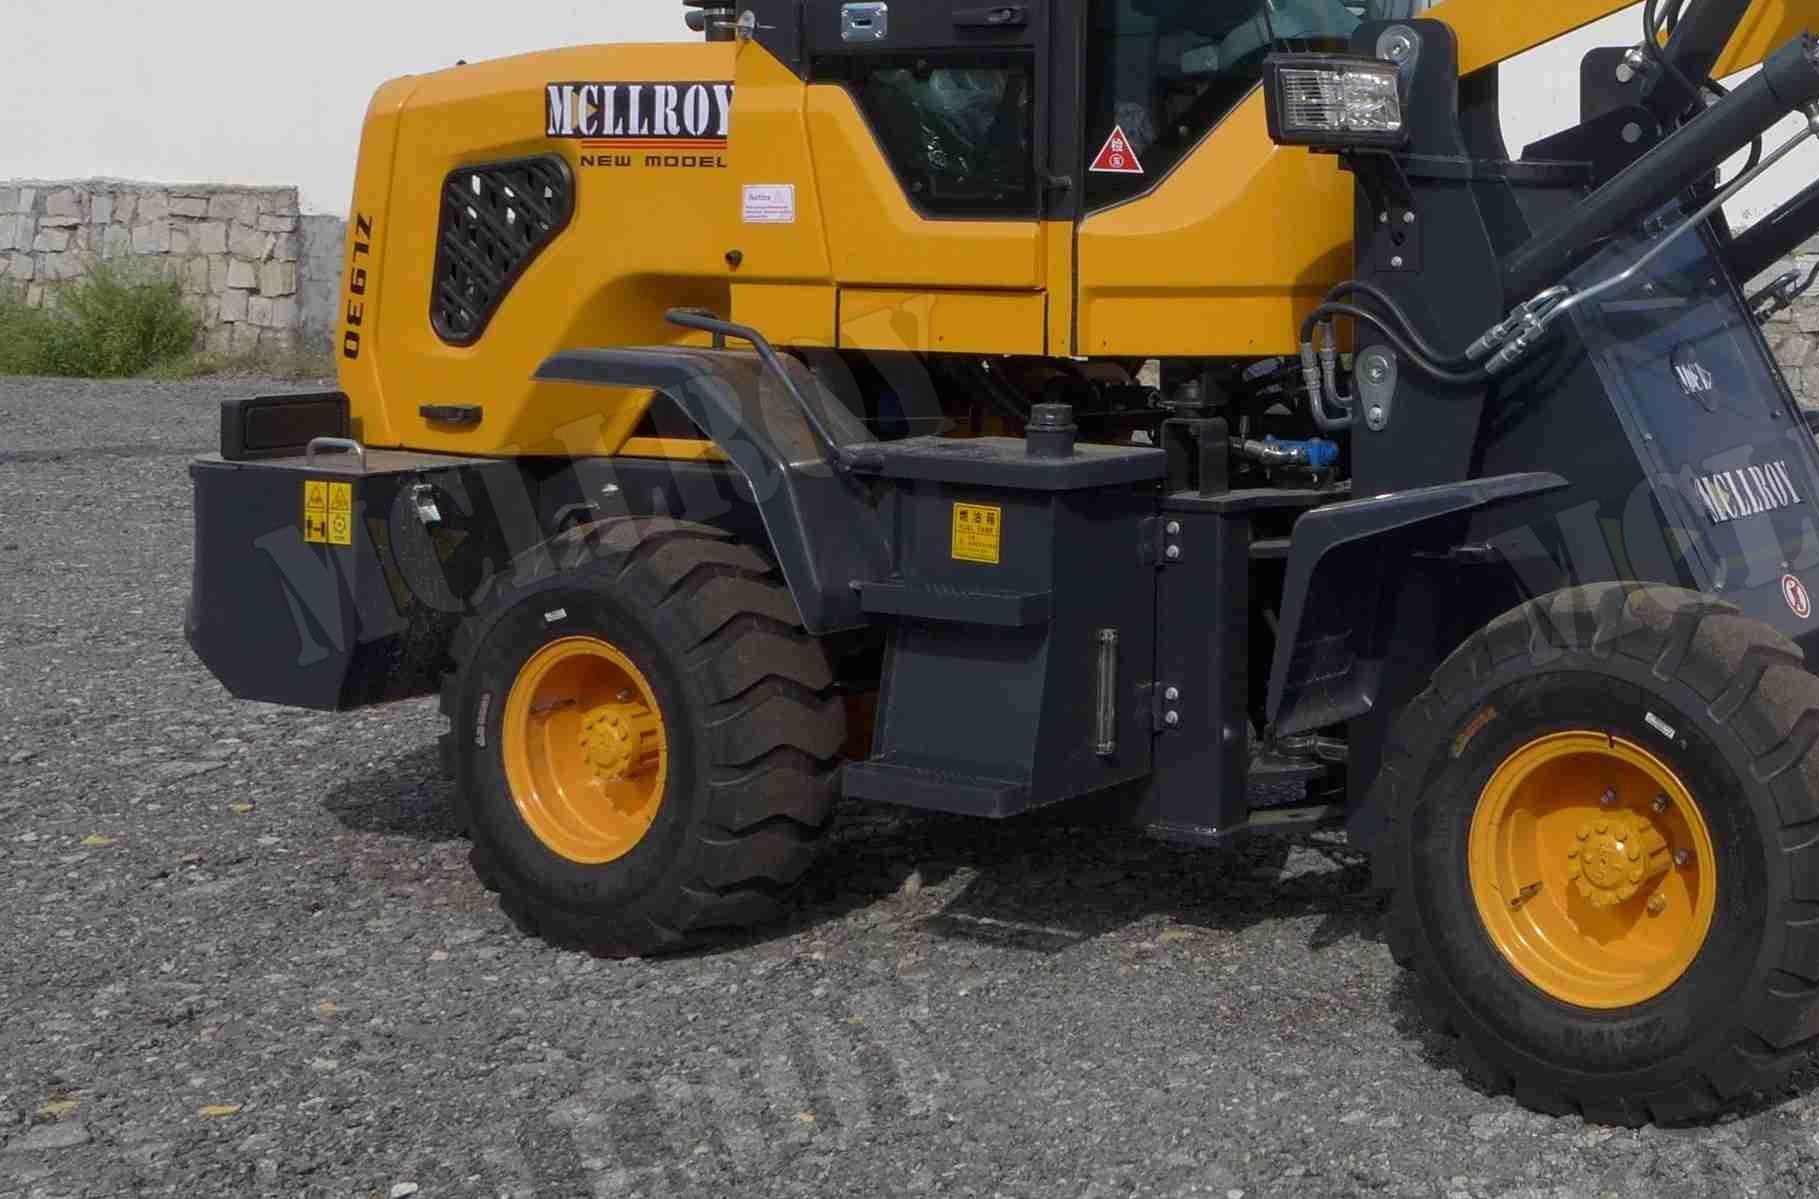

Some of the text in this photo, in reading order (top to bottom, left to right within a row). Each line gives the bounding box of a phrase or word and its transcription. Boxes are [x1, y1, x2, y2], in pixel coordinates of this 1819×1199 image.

[547, 84, 735, 136] MCLLROY
[580, 155, 727, 168] NEW MODEL
[343, 212, 373, 360] ZL930
[1694, 460, 1801, 523] MCLLROY
